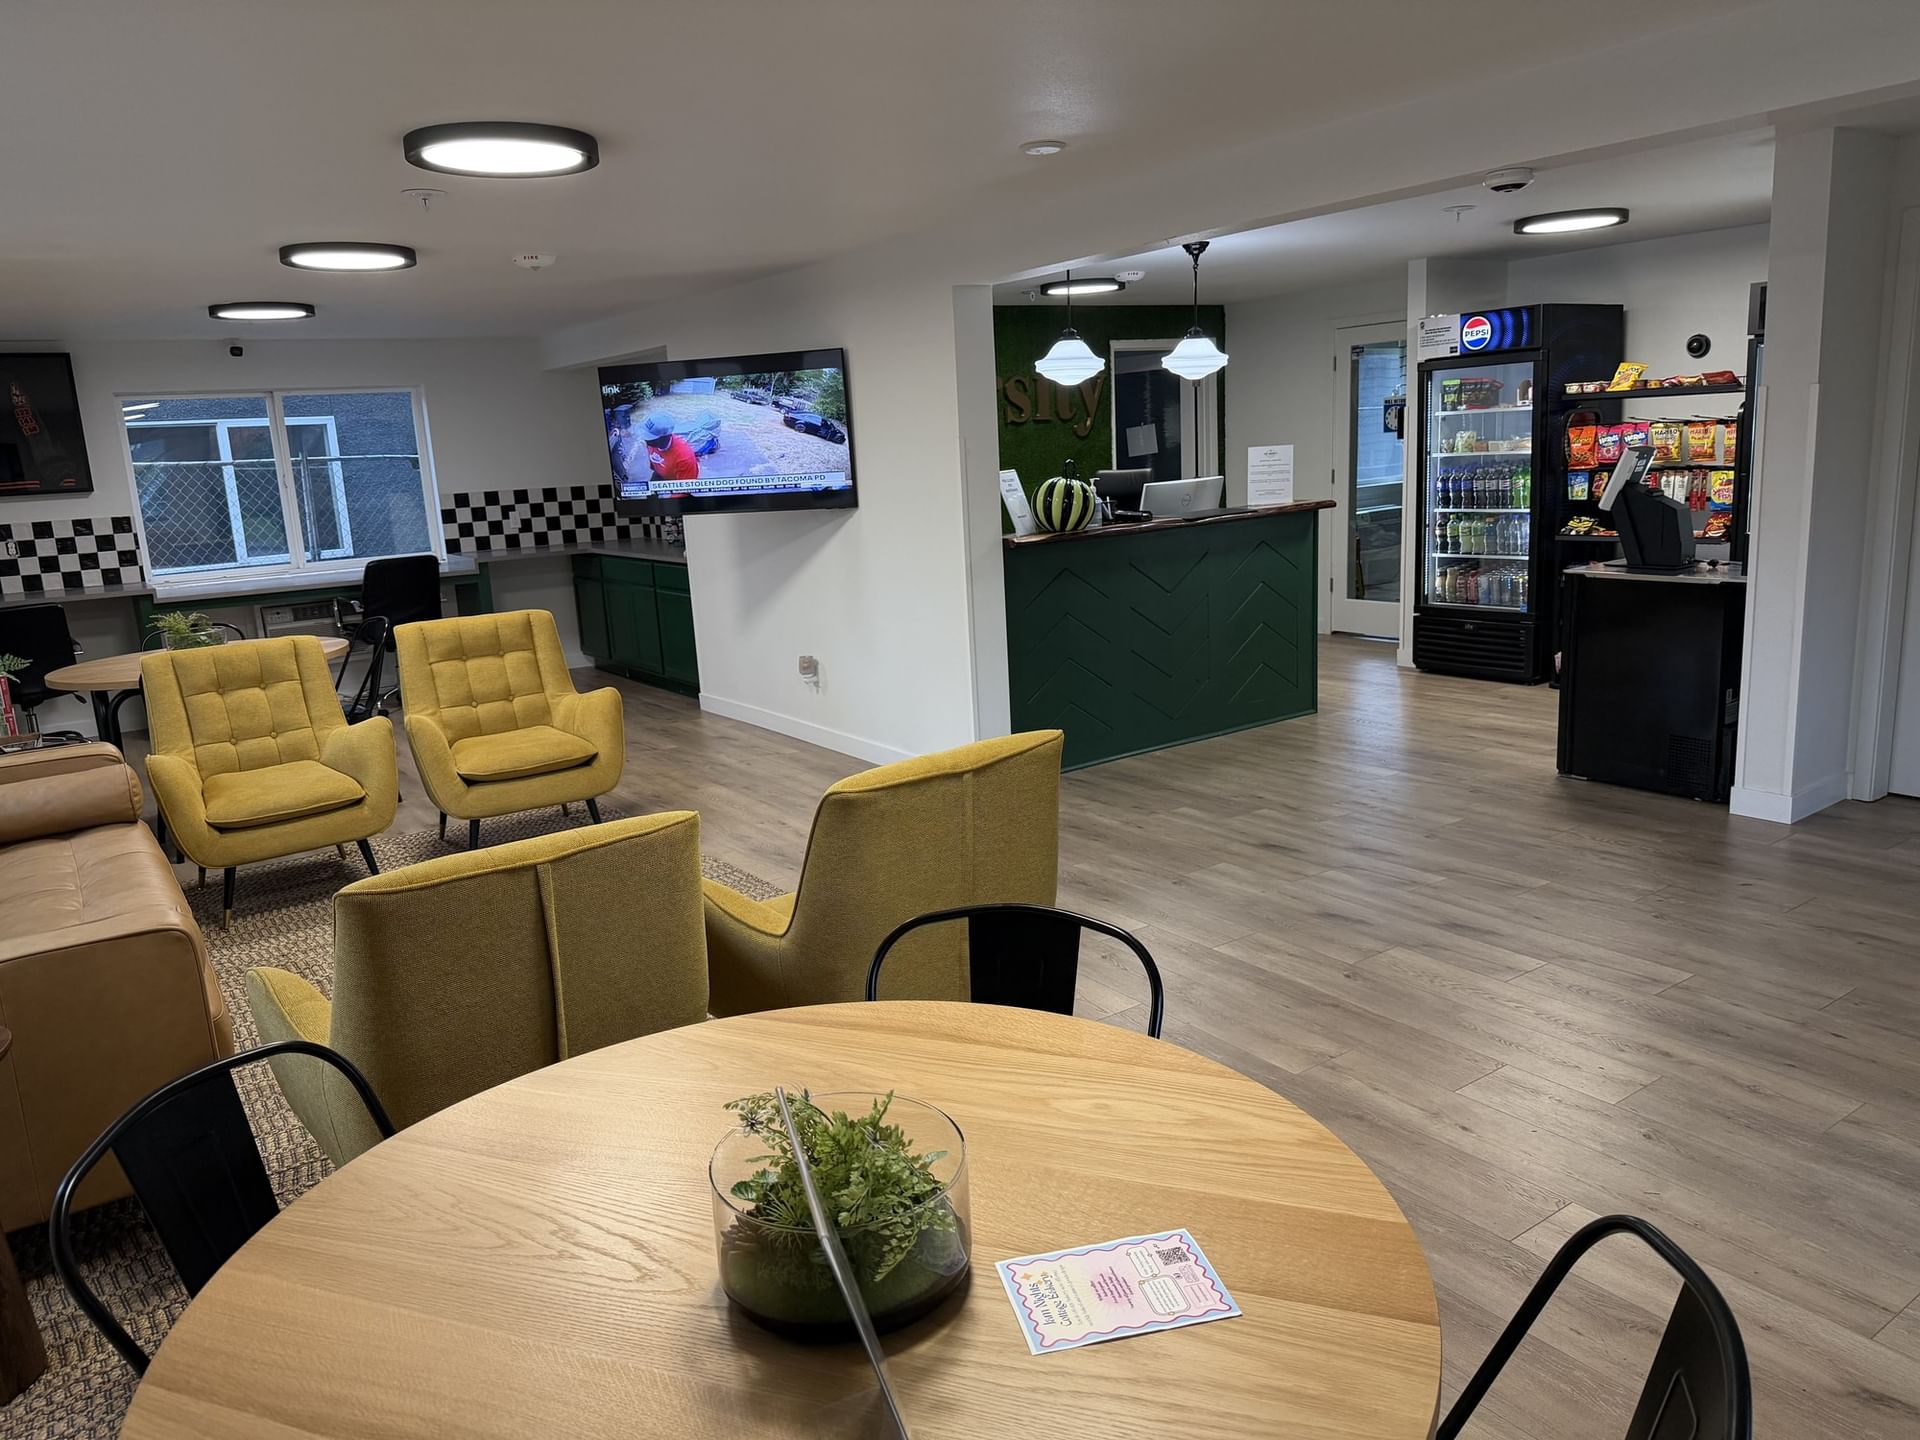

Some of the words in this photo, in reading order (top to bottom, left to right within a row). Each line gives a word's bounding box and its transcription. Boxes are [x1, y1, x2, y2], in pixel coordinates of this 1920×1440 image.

[1464, 328, 1489, 338] PEPSI
[997, 374, 1106, 437] sity
[652, 482, 684, 490] SEATTLE
[685, 480, 714, 488] STOLEN
[735, 477, 764, 485] FOUND
[777, 474, 813, 482] TACOMA
[814, 473, 826, 481] PD
[1029, 1282, 1047, 1308] Nights
[1041, 1273, 1059, 1299] Bakery
[1054, 1300, 1072, 1326] Cottage
